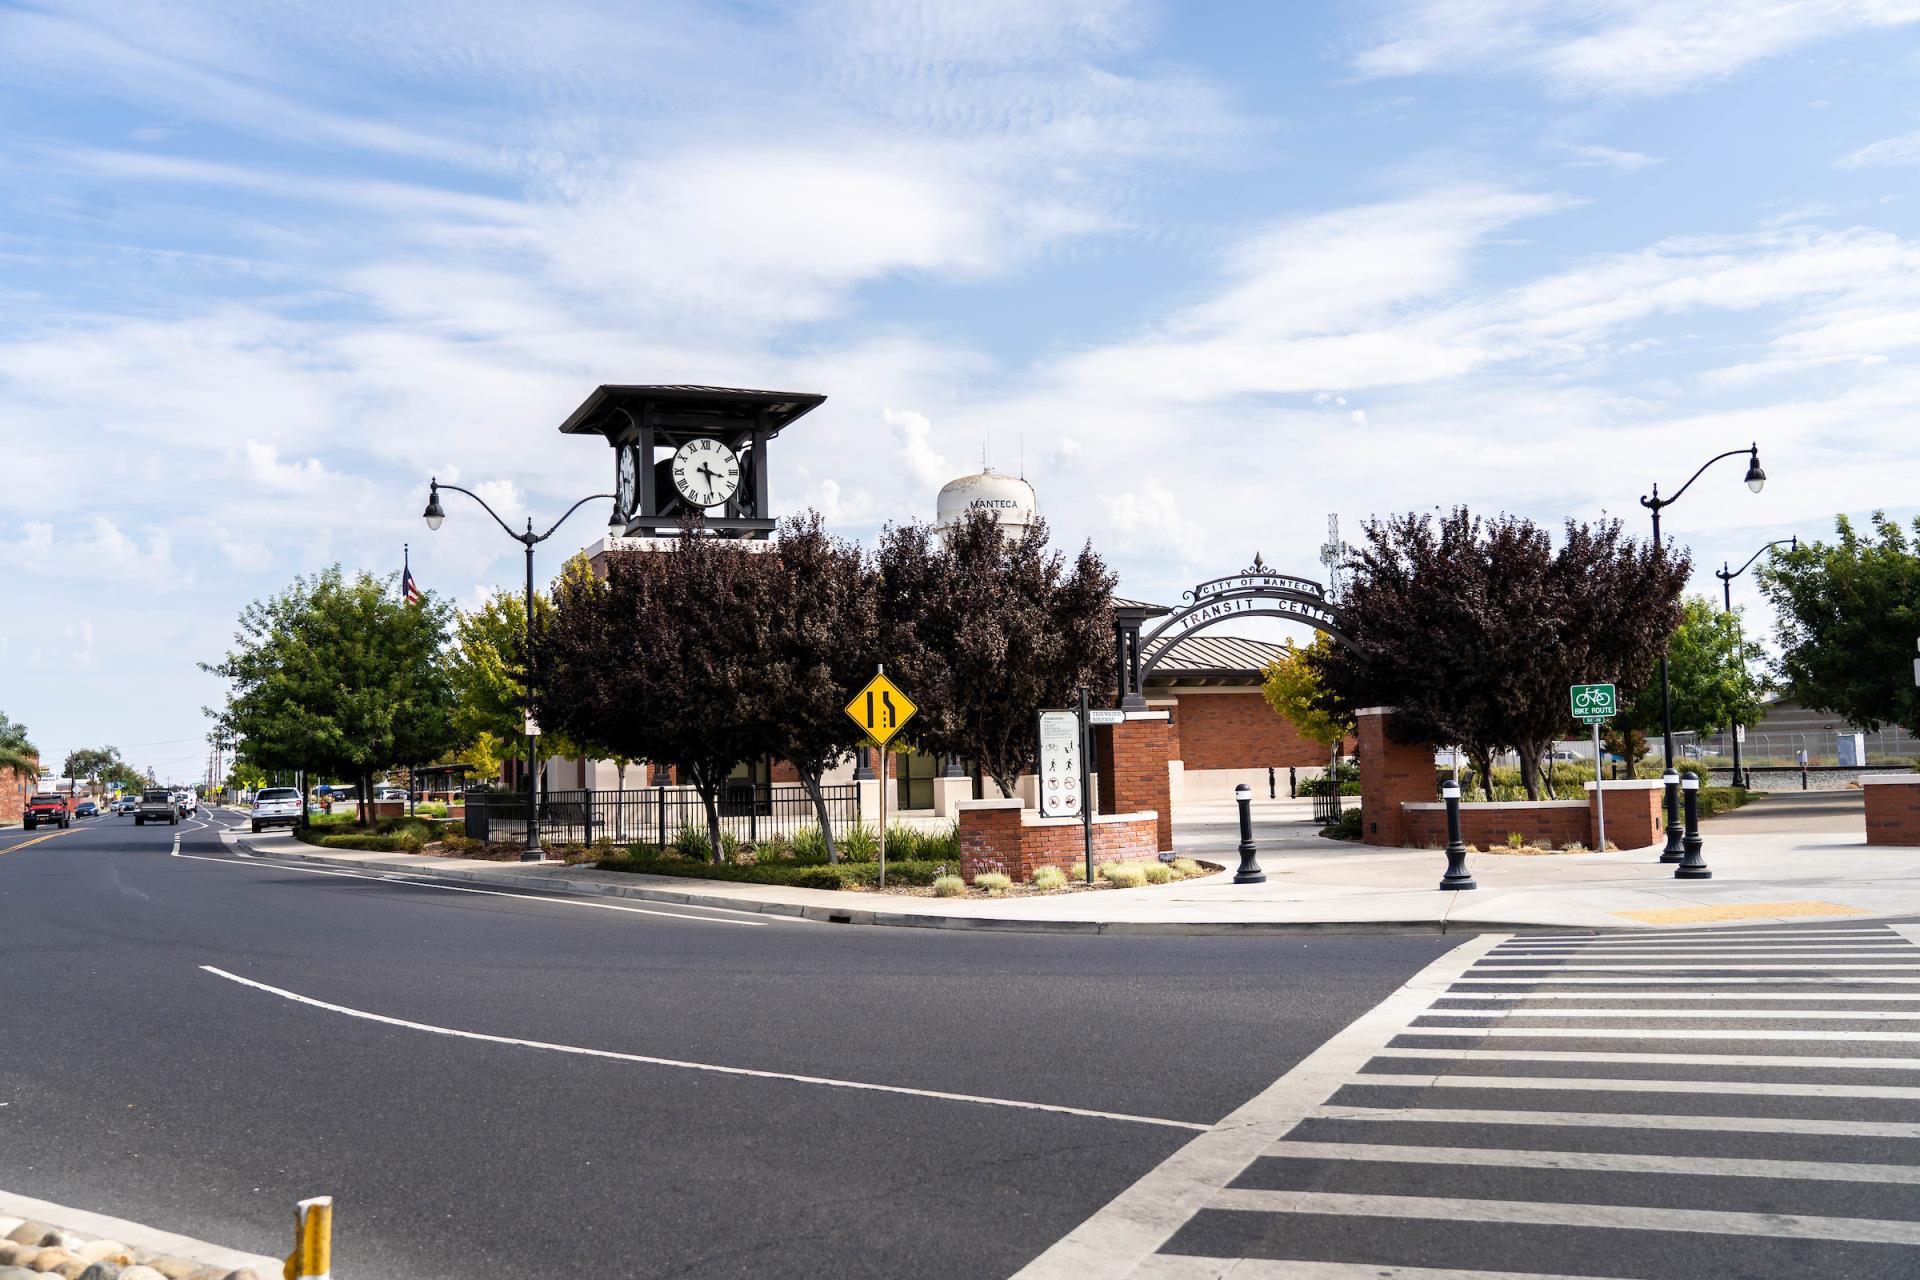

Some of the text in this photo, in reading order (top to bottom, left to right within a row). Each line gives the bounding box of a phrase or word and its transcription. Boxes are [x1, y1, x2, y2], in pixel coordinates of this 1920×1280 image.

[687, 442, 698, 454] XI
[701, 440, 711, 450] XII
[677, 453, 688, 463] X
[724, 455, 734, 463] II
[674, 467, 685, 476] IX
[725, 481, 736, 492] IV
[703, 494, 712, 504] VI
[970, 499, 1018, 508] MANTECA
[1203, 578, 1315, 594] CITY OF MANTECA
[1180, 599, 1253, 629] TRANSIT
